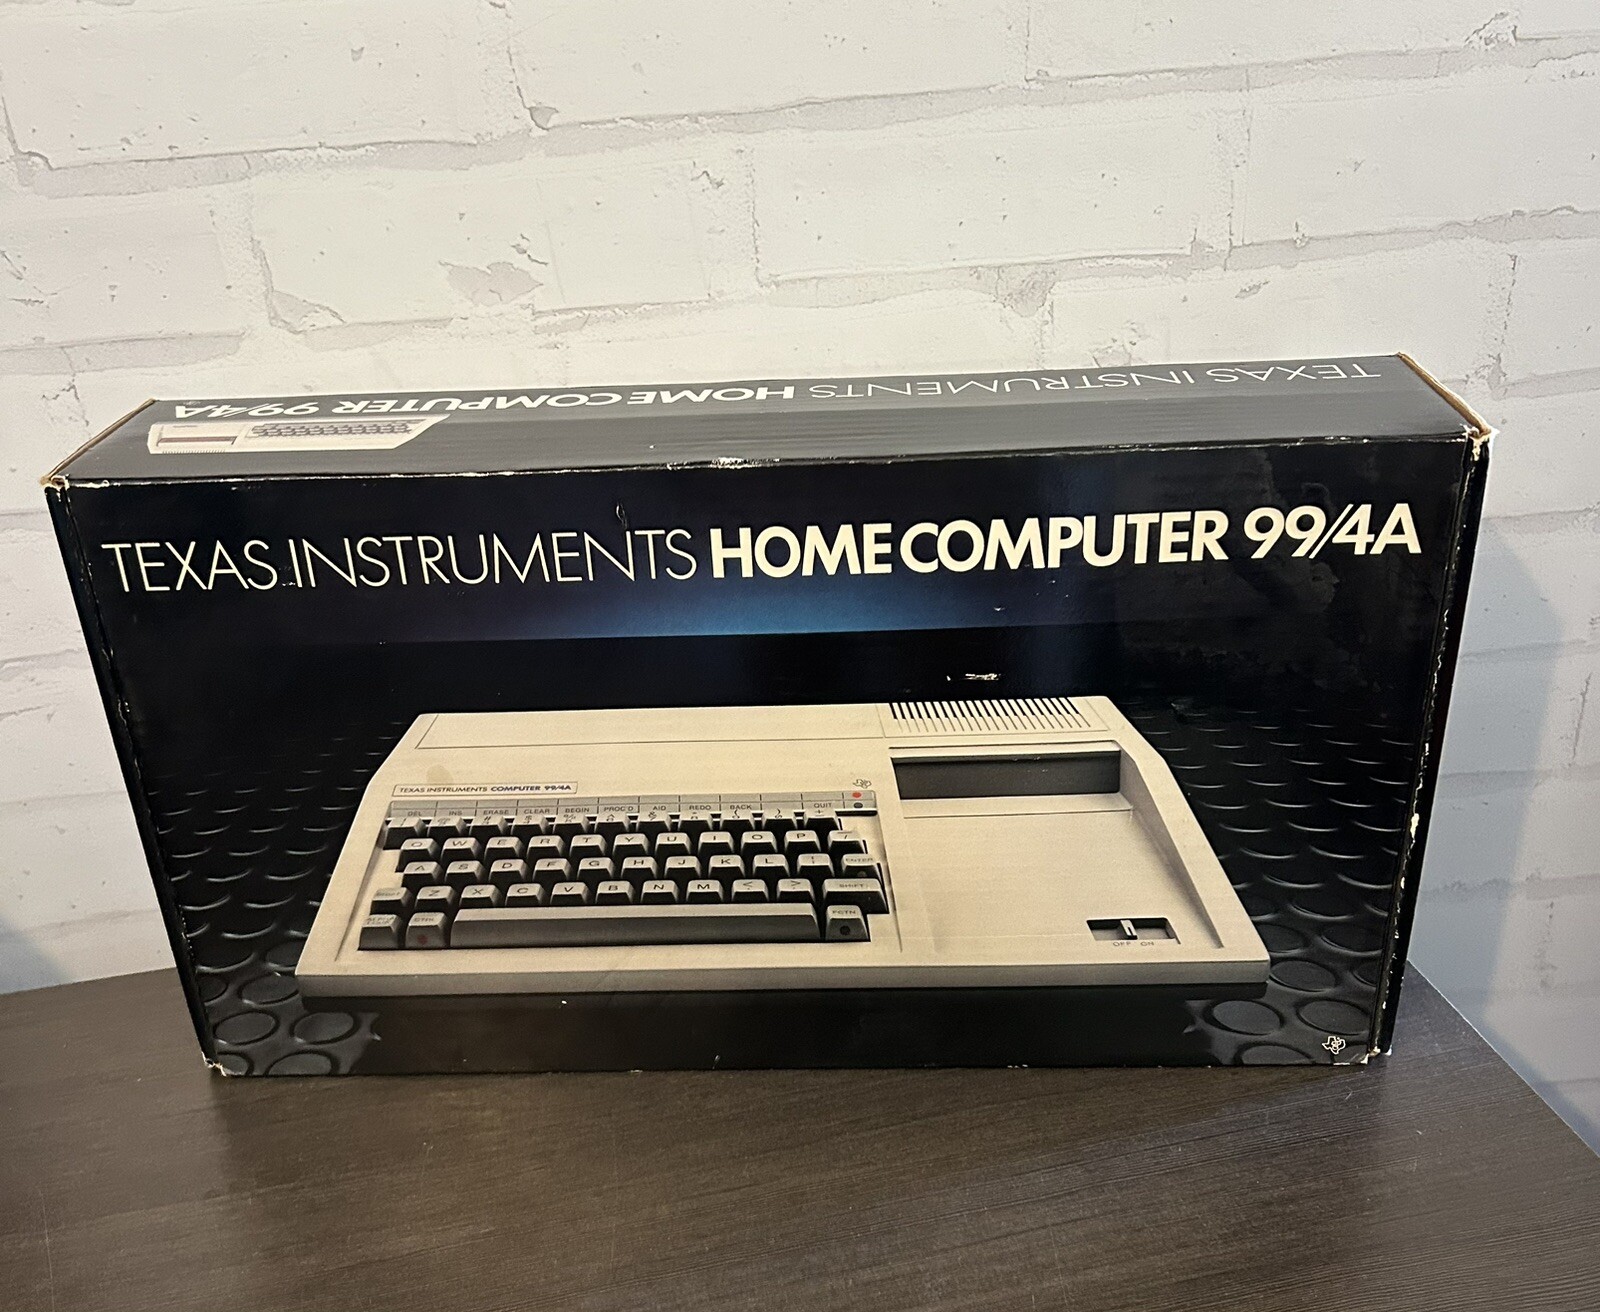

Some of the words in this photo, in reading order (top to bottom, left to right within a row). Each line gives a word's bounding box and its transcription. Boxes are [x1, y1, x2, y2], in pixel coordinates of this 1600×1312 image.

[1206, 363, 1382, 383] TEXAS
[626, 385, 795, 405] HOME
[808, 370, 1195, 399] INSTRUMENTS
[175, 402, 319, 419] 99/4A
[331, 392, 623, 414] COMPUTER
[101, 539, 277, 593] TEXAS
[287, 528, 698, 588] INSTRUMENTS
[709, 522, 893, 579] HOME
[899, 509, 1230, 574] COMPUTER
[1242, 503, 1422, 559] 99/4A
